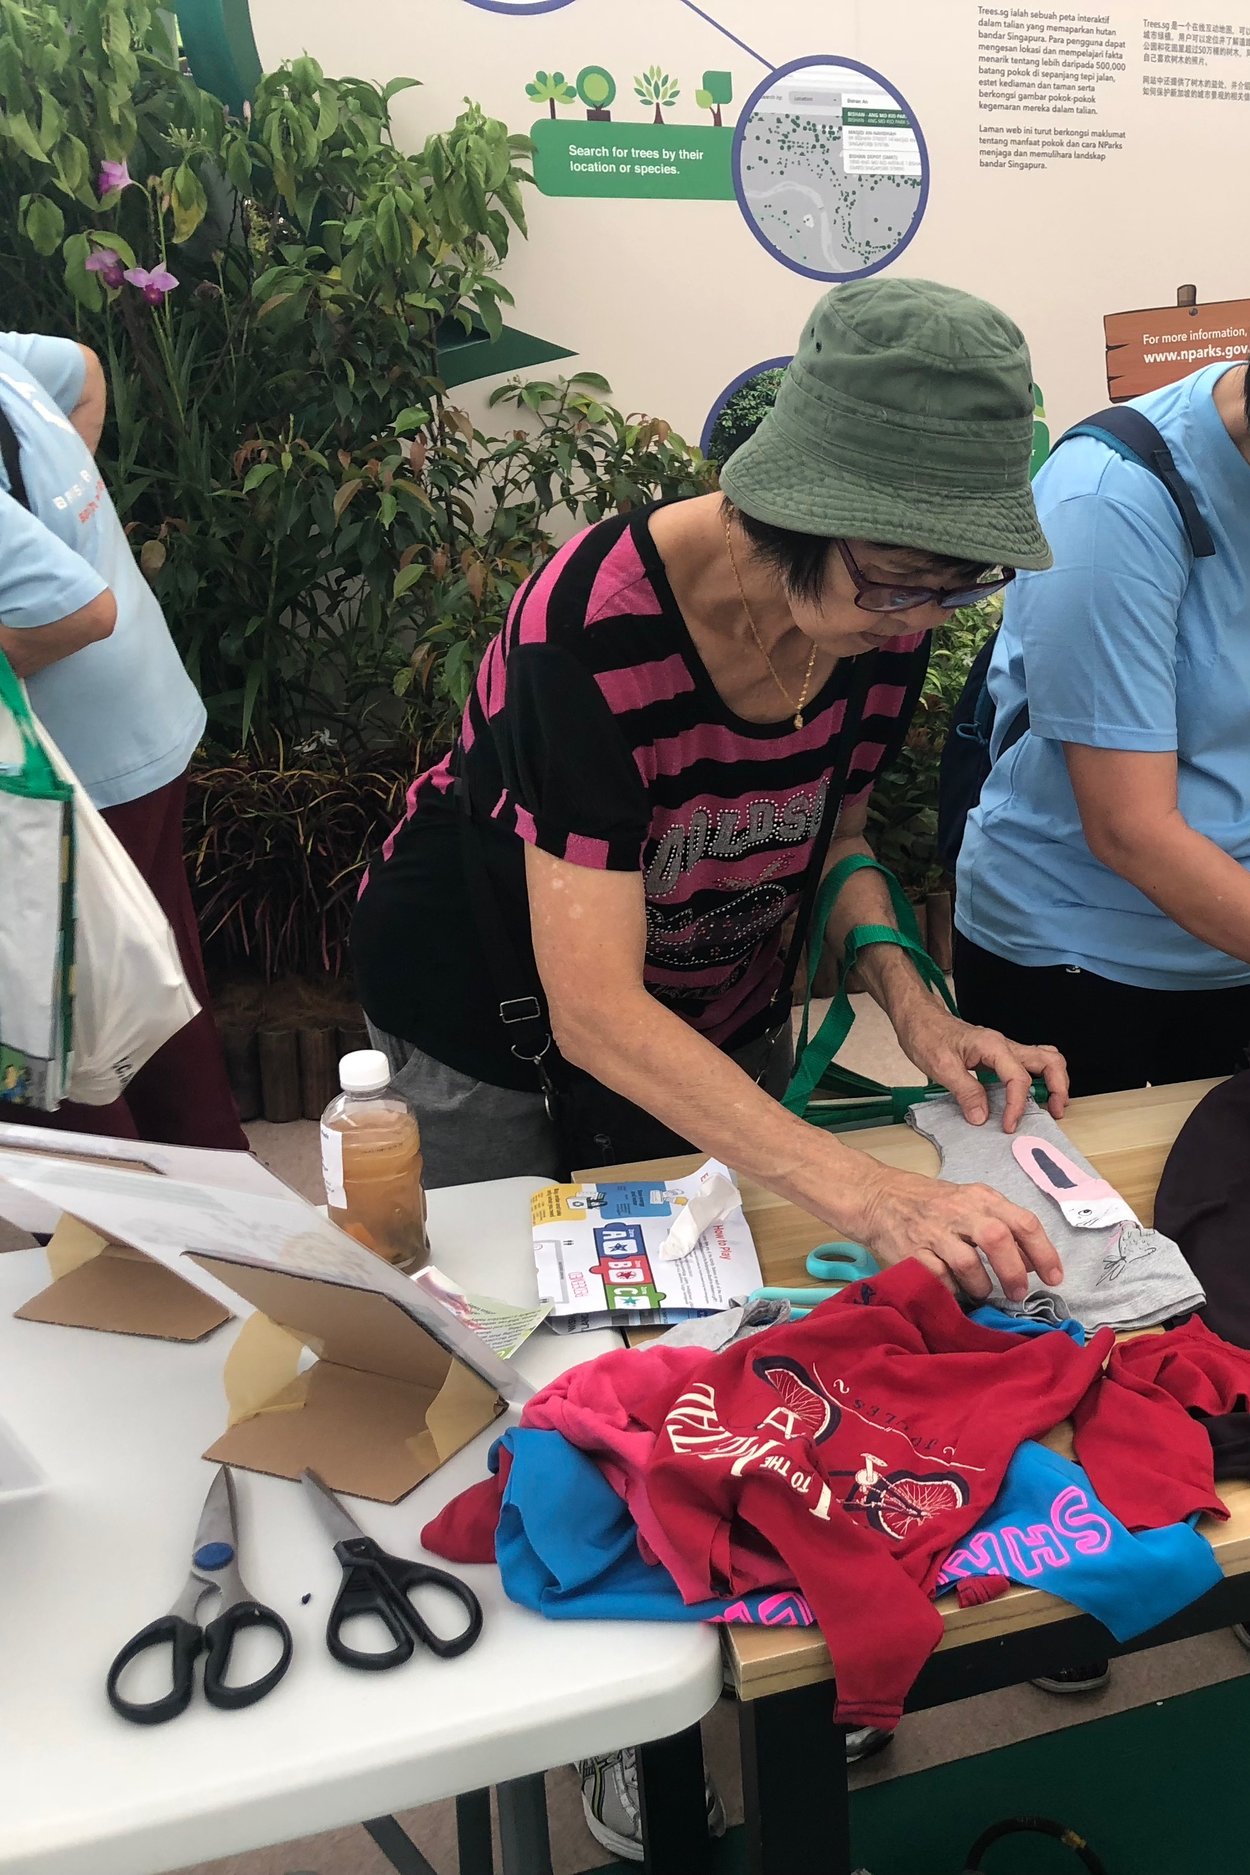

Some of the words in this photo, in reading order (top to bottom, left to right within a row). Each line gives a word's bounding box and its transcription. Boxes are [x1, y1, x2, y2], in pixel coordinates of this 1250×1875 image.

[978, 6, 1009, 18] Trees.sg
[1010, 9, 1028, 17] ialah
[1030, 10, 1057, 20] sebuah
[1059, 13, 1075, 22] peta
[1077, 14, 1110, 24] interaktif
[978, 19, 1001, 27] dalam
[1004, 21, 1024, 29] talian
[1026, 23, 1044, 32] yang
[1046, 24, 1094, 34] memaparkan
[1096, 27, 1116, 36] hutan
[978, 31, 1005, 39] bandar
[1007, 32, 1047, 44] Singapura.
[1049, 35, 1064, 44] Para
[1066, 38, 1103, 48] pengguna
[1105, 40, 1126, 49] dapat
[978, 44, 1017, 53] mengesan
[1019, 45, 1041, 53] lokasi
[1043, 47, 1057, 55] dan
[1058, 49, 1103, 60] mempelajari
[1105, 51, 1123, 60] fakta
[979, 55, 1009, 63] menarik
[1011, 57, 1039, 67] tentang
[1042, 58, 1060, 67] lebih
[1062, 60, 1094, 70] daripada
[1096, 62, 1126, 71] 500,000
[979, 66, 1005, 76] batang
[1007, 68, 1030, 77] pokok
[1032, 68, 1039, 77] di
[1041, 70, 1079, 82] sepanjang
[1081, 72, 1095, 82] tepi
[1096, 73, 1115, 83] jalan,
[979, 78, 997, 86] estet
[999, 79, 1036, 88] kediaman
[1038, 81, 1051, 89] dan
[1053, 82, 1076, 91] taman
[1077, 84, 1095, 92] serta
[979, 90, 1016, 100] berkongsi
[1018, 92, 1046, 101] gambar
[1049, 92, 1096, 103] pokok-pokok
[979, 102, 1021, 112] kegemaran
[1023, 104, 1050, 112] mereka
[1076, 107, 1098, 115] talian.
[979, 125, 1004, 133] Laman
[1006, 126, 1022, 134] web
[1053, 128, 1089, 138] berkongsi
[1091, 130, 1126, 138] maklumat
[979, 137, 1008, 147] tentang
[1010, 138, 1040, 146] manfaat
[1042, 139, 1064, 148] pokok
[1098, 141, 1123, 149] NParks
[568, 144, 609, 160] Search
[611, 146, 628, 160] for
[630, 148, 660, 161] trees
[662, 149, 678, 165] by
[678, 149, 704, 162] their
[980, 150, 1012, 158] menjaga
[1014, 149, 1028, 157] dan
[1030, 151, 1072, 159] memulihara
[1074, 151, 1106, 161] landskap
[569, 160, 617, 173] location
[620, 162, 633, 174] or
[634, 162, 680, 176] species.
[980, 160, 1006, 168] bandar
[1008, 161, 1047, 170] Singapura.
[1143, 334, 1159, 344] For
[1162, 332, 1187, 343] more
[1190, 327, 1248, 341] information,
[1143, 344, 1250, 363] www.nparks.gov.
[713, 1224, 724, 1241] How
[720, 1247, 732, 1261] Play
[759, 1453, 792, 1478] THE
[790, 1471, 811, 1494] TO
